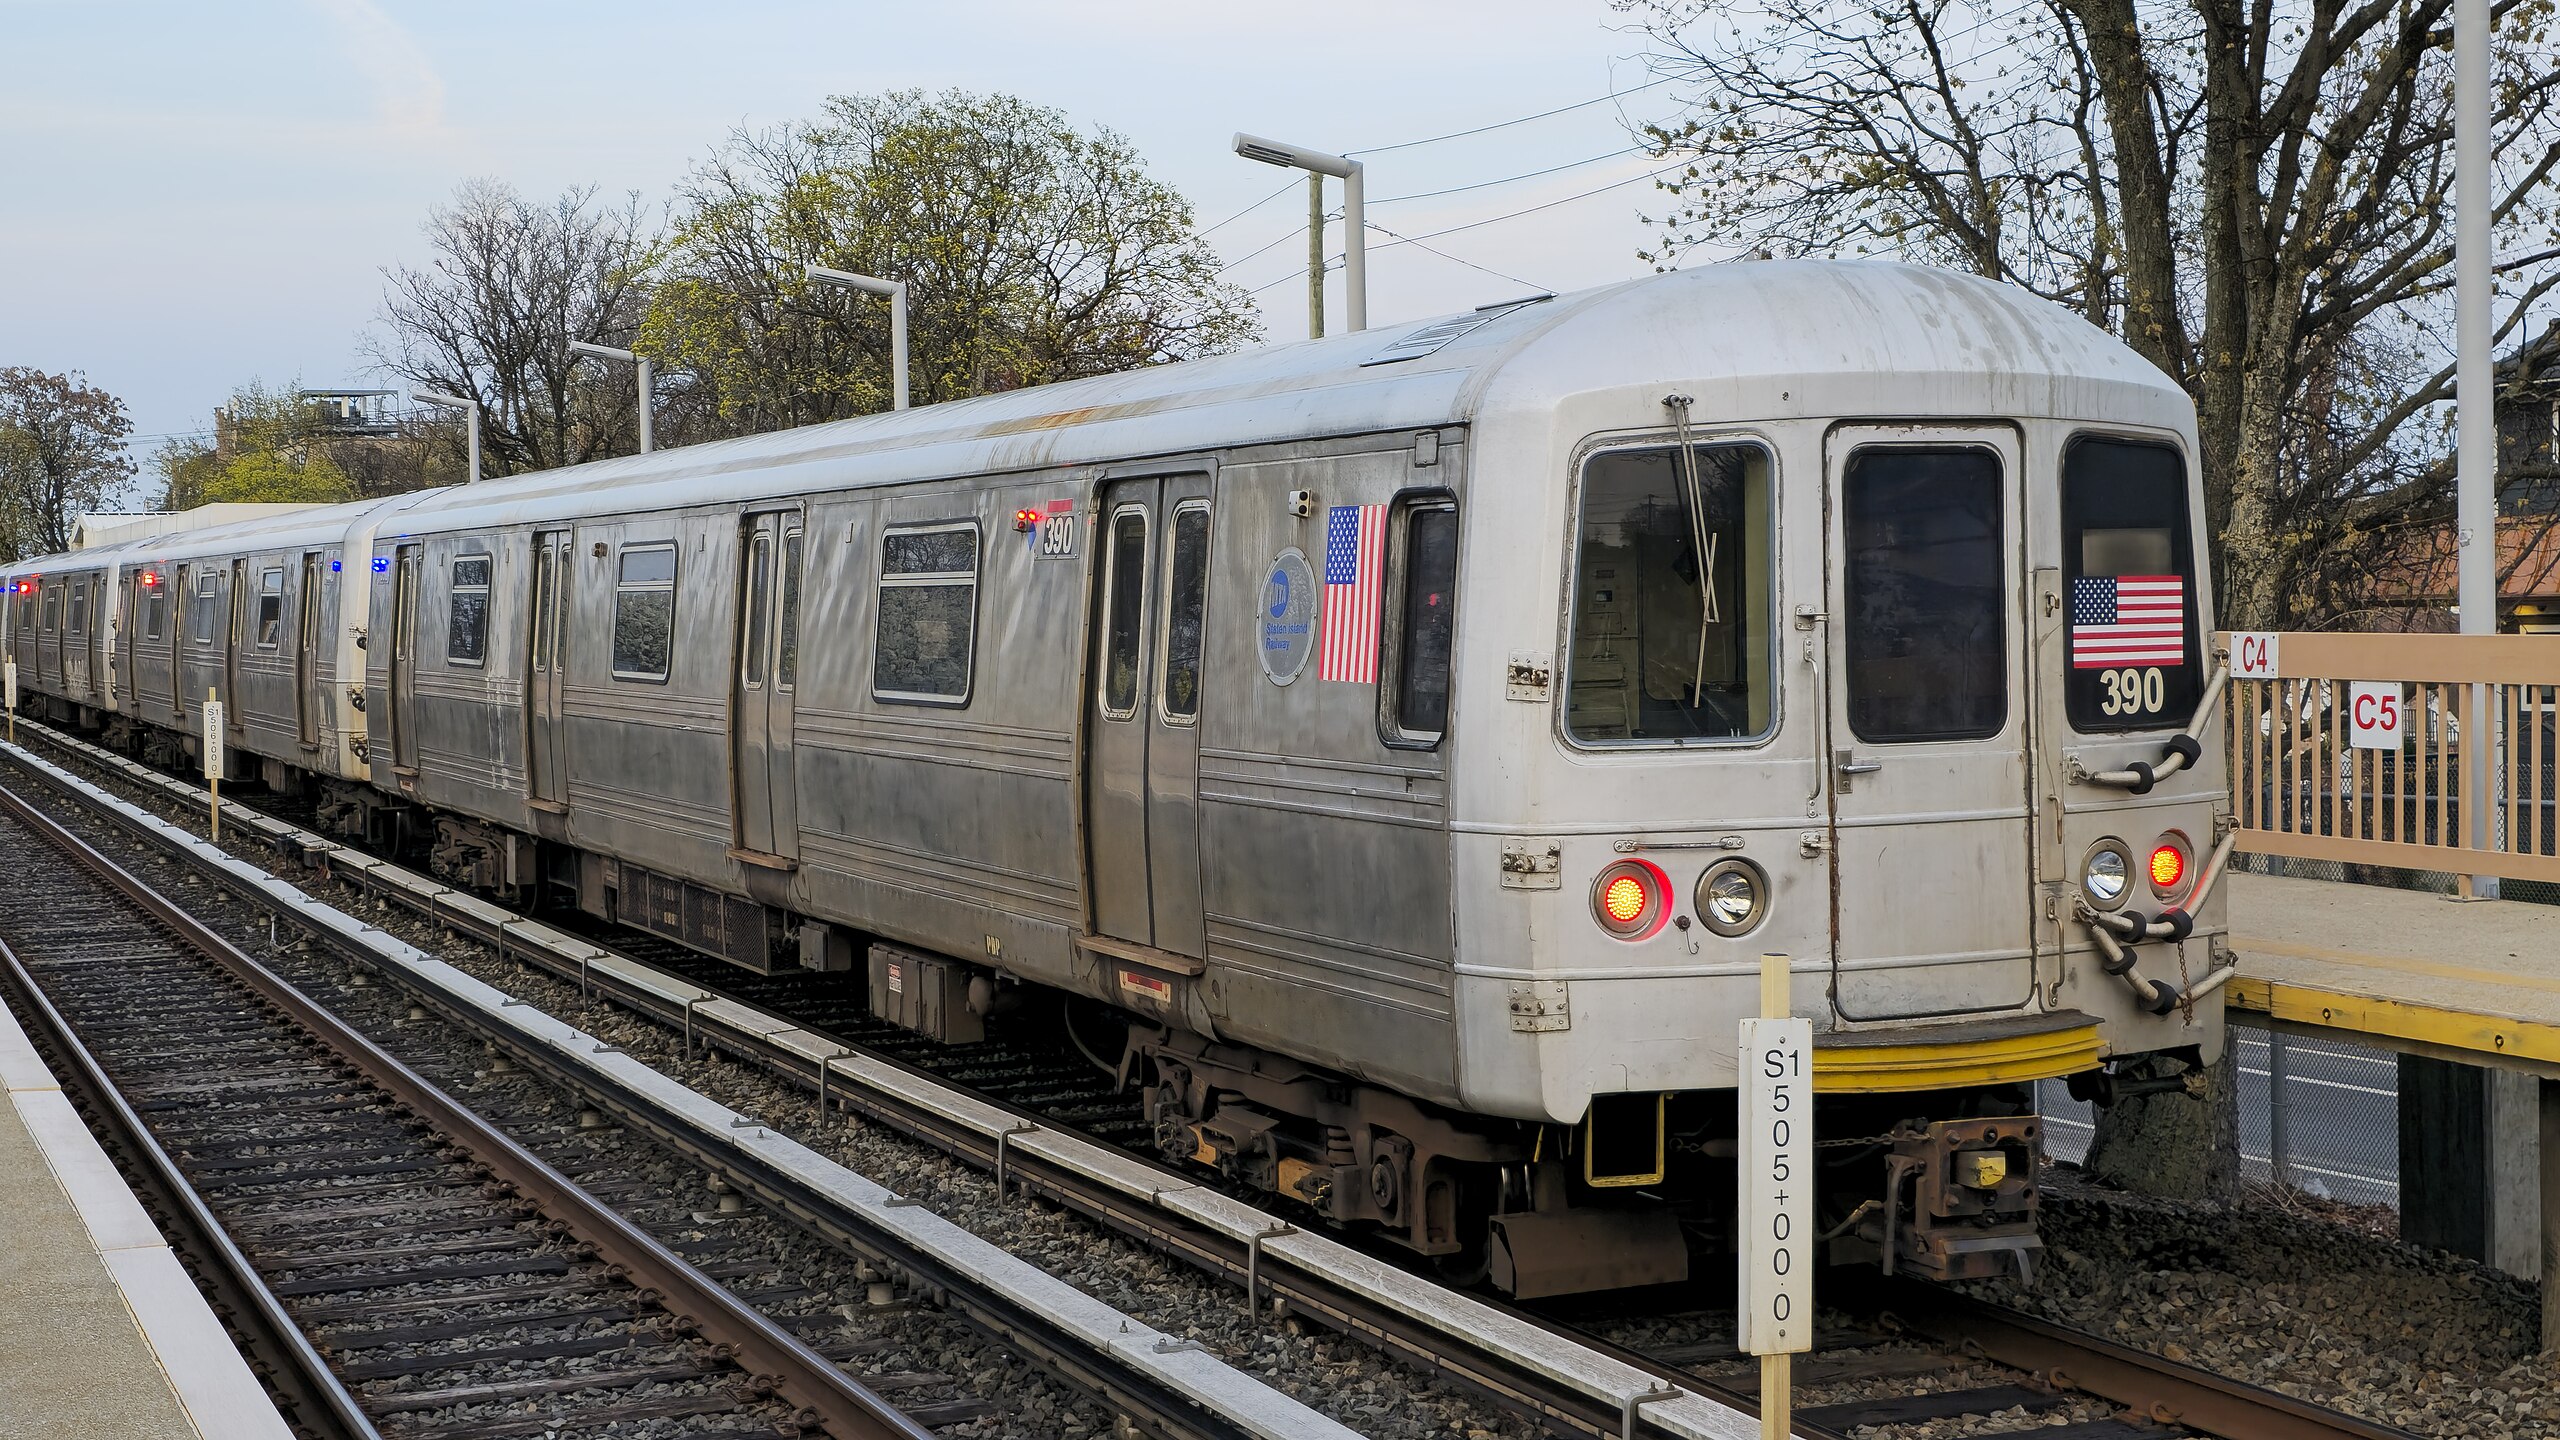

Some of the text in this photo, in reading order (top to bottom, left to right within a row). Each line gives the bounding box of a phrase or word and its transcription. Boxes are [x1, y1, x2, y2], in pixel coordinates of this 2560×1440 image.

[1044, 516, 1074, 554] 390
[1265, 637, 1290, 651] Railway
[1266, 620, 1308, 636] Staten Island
[2242, 635, 2268, 673] C4
[2100, 667, 2164, 716] 390
[207, 708, 219, 716] S1
[2354, 693, 2398, 731] C5
[1764, 1049, 1799, 1078] S1
